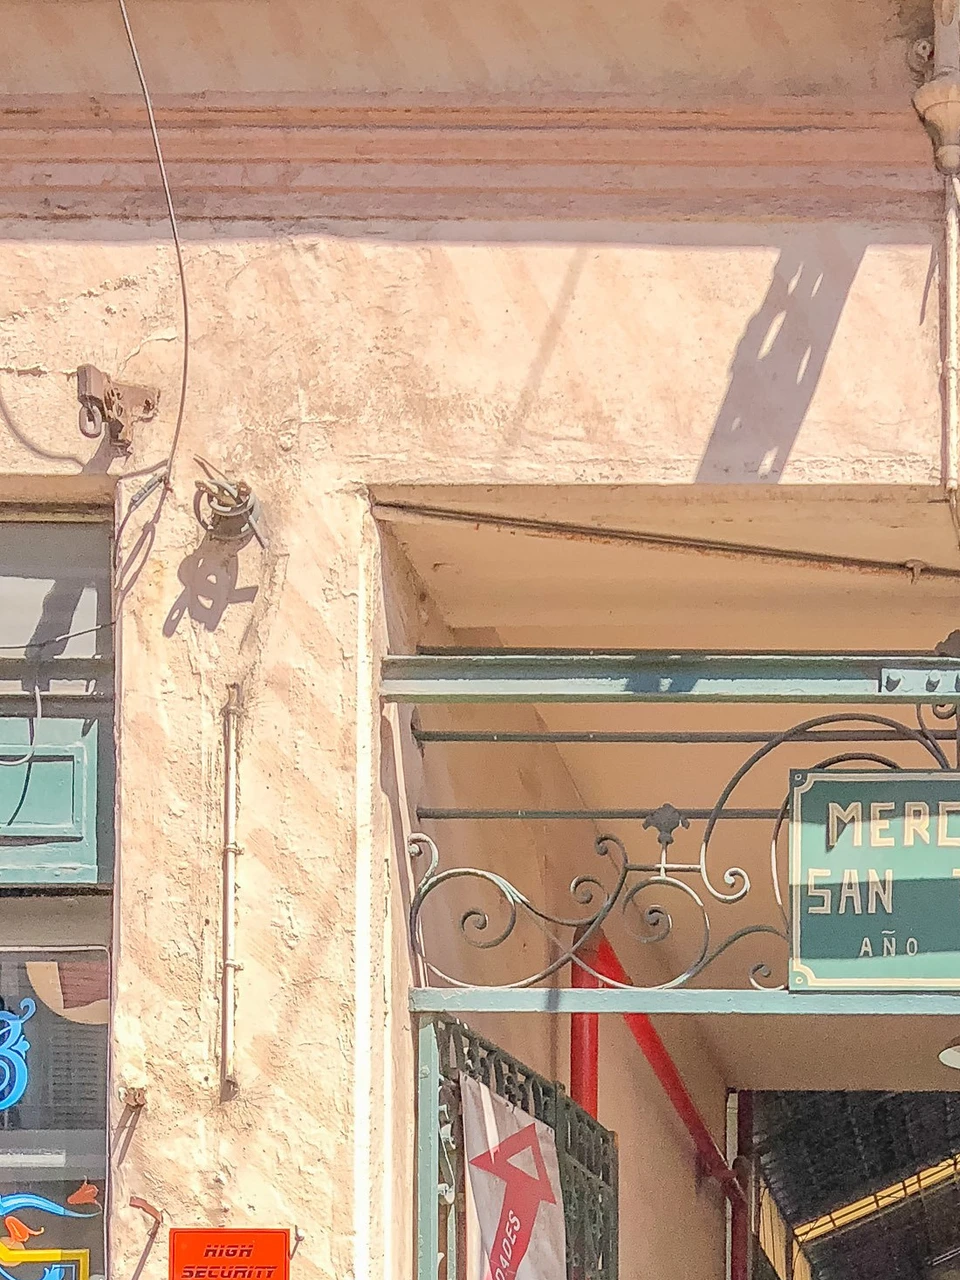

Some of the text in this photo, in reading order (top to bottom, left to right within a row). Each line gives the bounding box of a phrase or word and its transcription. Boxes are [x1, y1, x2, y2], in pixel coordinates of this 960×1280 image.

[807, 868, 893, 915] SAN
[858, 930, 919, 957] AÑO
[203, 1245, 254, 1257] HIGH
[181, 1266, 278, 1278] SECURITY
